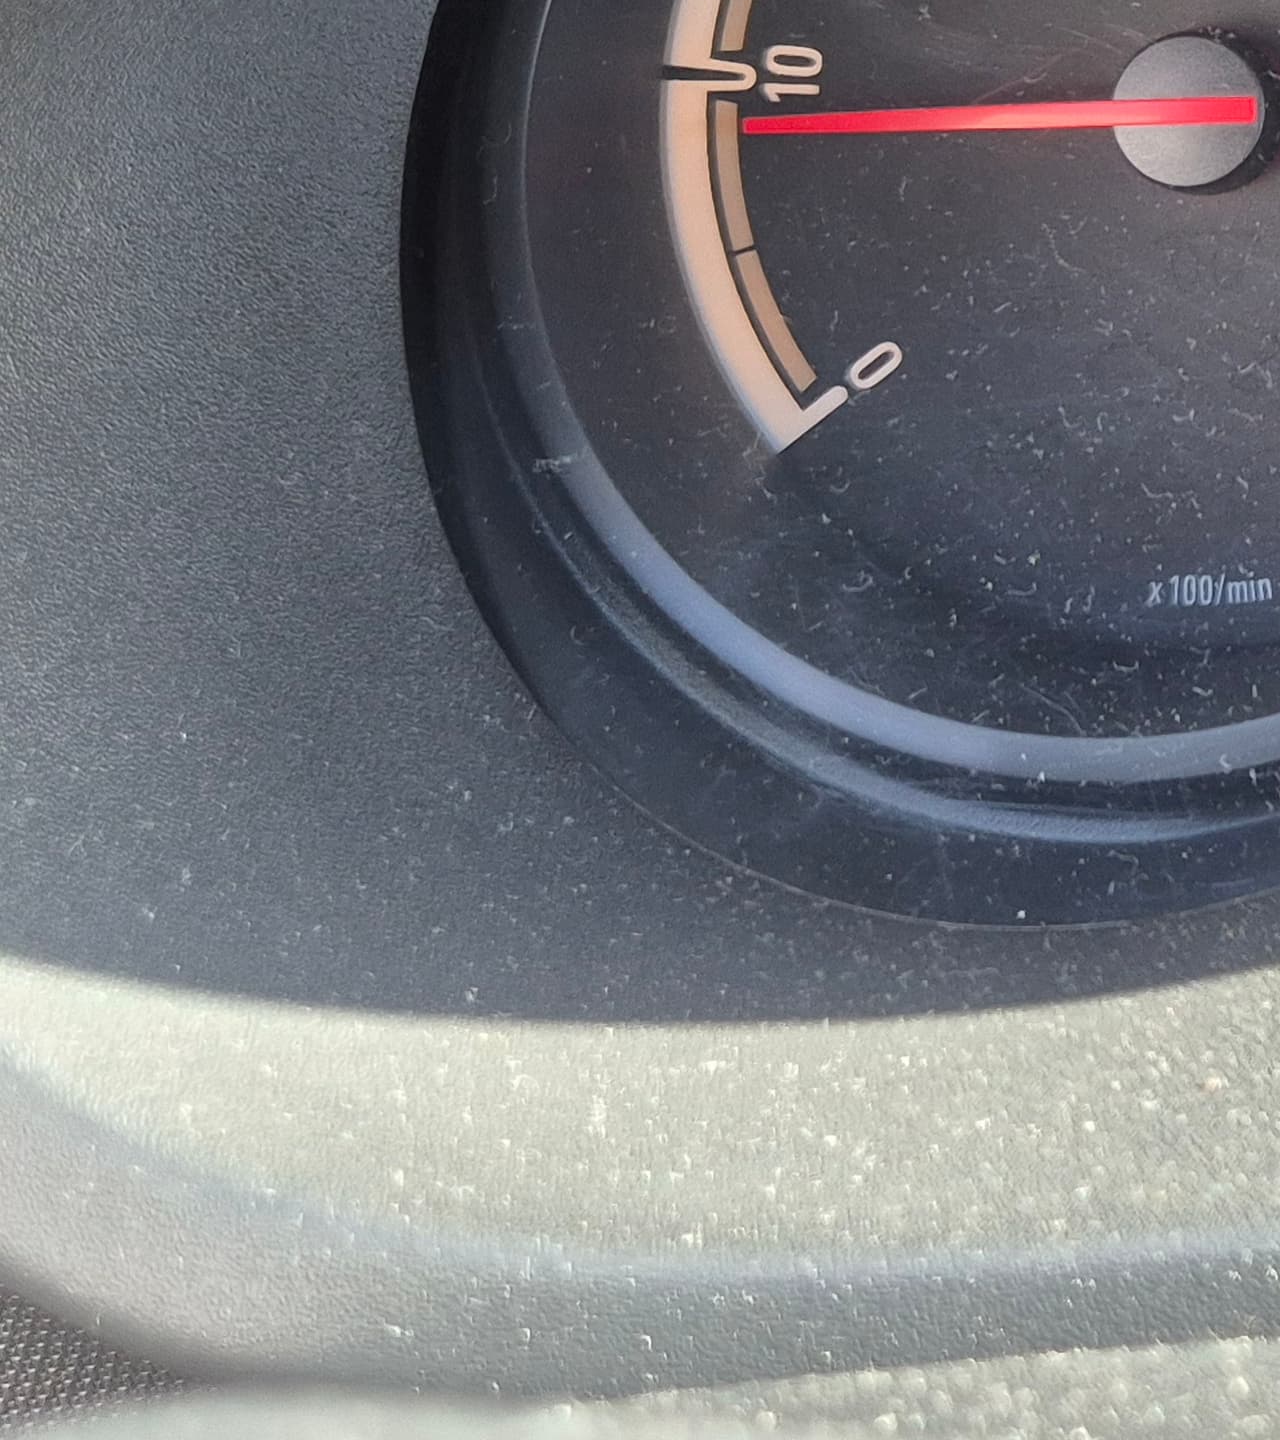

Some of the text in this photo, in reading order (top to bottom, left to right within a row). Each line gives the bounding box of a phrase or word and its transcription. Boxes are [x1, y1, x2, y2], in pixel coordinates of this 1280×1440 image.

[763, 44, 823, 103] 10
[848, 341, 904, 392] 0
[1170, 573, 1273, 606] 100/min
